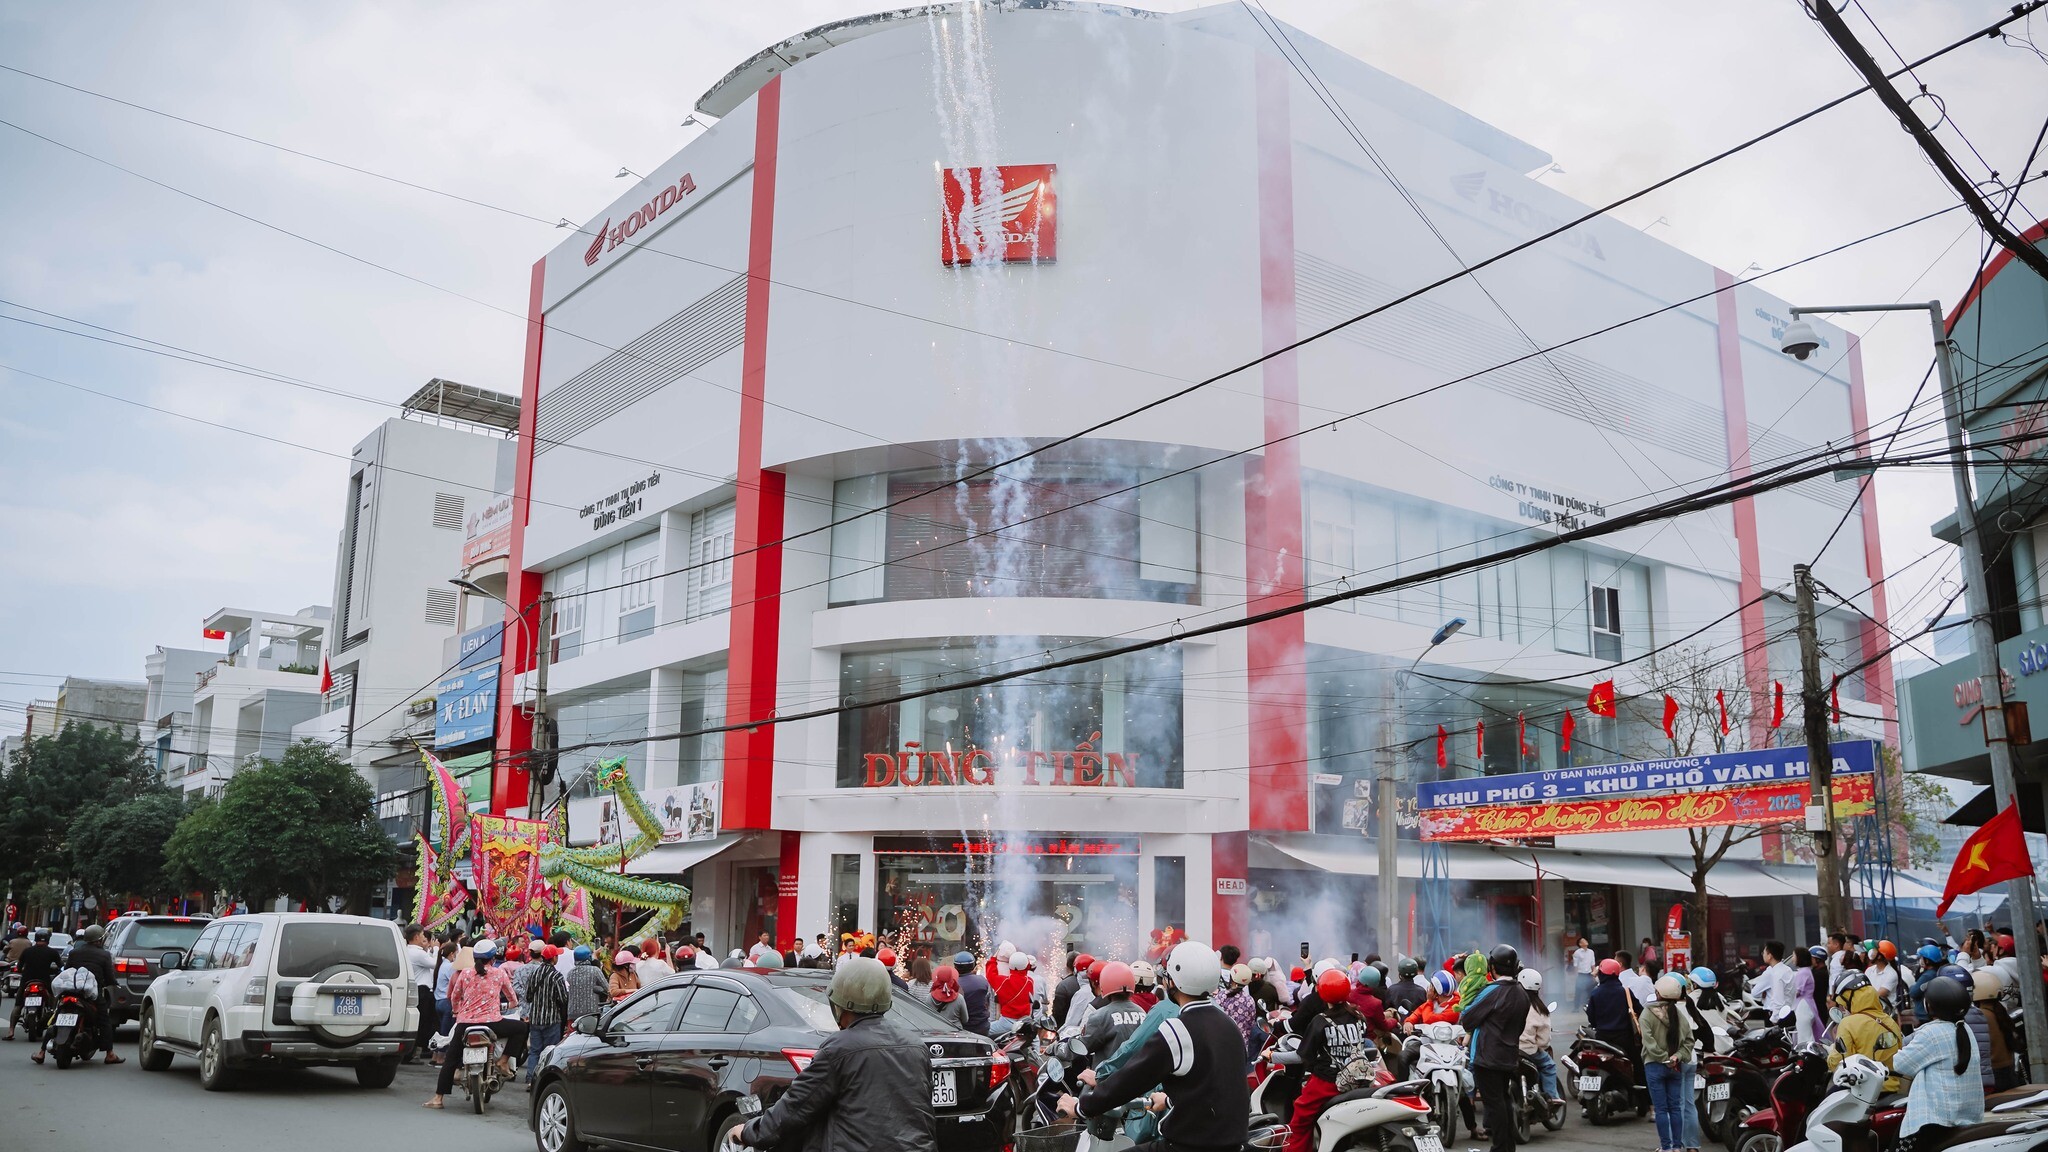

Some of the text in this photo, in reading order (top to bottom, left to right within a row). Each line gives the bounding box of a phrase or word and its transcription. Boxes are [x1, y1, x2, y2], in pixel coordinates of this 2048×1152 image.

[607, 172, 697, 253] HONDA
[596, 500, 604, 512] TY
[1489, 474, 1606, 518] CÔNG TY TNHH TM DŨNG TIẾN
[594, 497, 642, 531] DŨNG TIẾN 1
[1519, 501, 1552, 523] DŨNG
[1554, 508, 1578, 530] TIẾN
[2019, 640, 2048, 677] SÁC
[863, 731, 1140, 788] DŨNG TIẾN
[1543, 758, 1711, 781] ỦY BAN NHÂN DÂN PHƯỜNG 4
[1433, 791, 1479, 806] KHU
[1486, 782, 1535, 802] PHỐ
[1543, 784, 1558, 797] 3
[1584, 776, 1638, 793] KHU
[1647, 765, 1704, 788] PHỐ
[1712, 763, 1775, 781] VĂN
[1785, 757, 1851, 777] HA
[1476, 795, 1726, 832] Chúc Mừng Năm Mới
[1768, 794, 1802, 811] 2025
[1219, 881, 1244, 889] HEAD
[917, 904, 967, 941] 20
[337, 1006, 359, 1014] 0850
[340, 997, 356, 1005] 78B
[933, 1073, 946, 1087] 8A
[933, 1088, 954, 1102] 5.50
